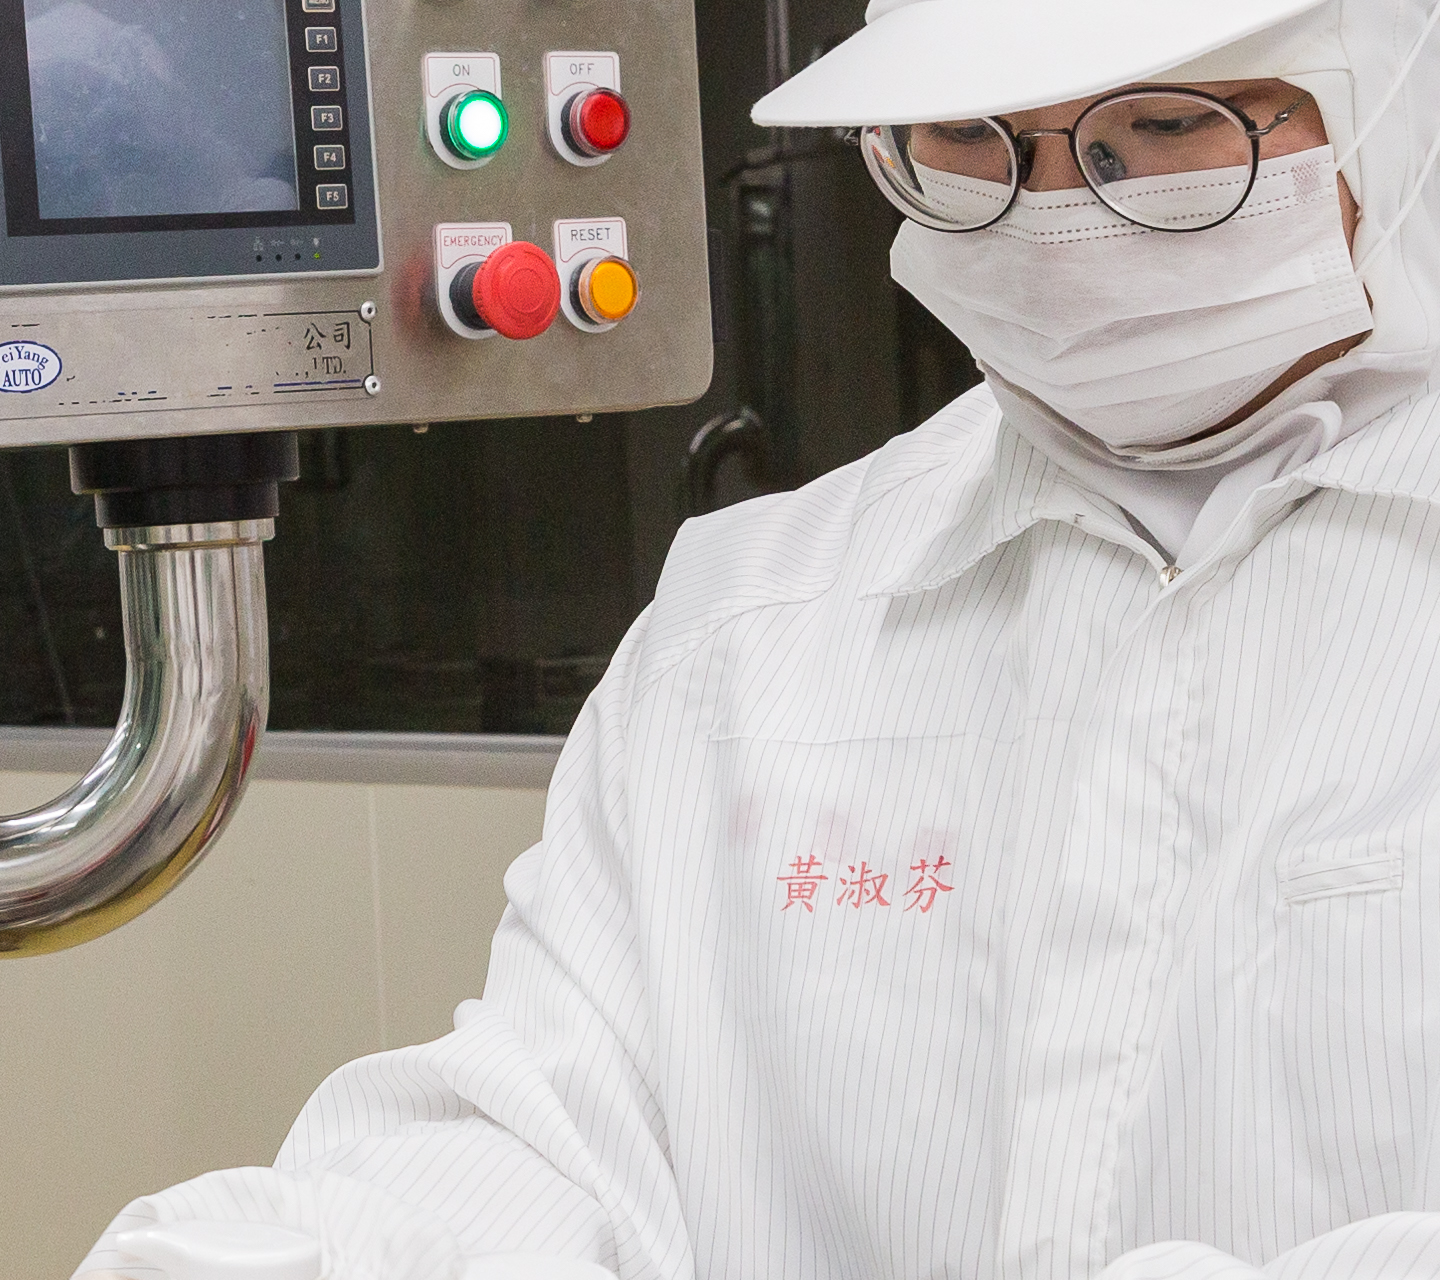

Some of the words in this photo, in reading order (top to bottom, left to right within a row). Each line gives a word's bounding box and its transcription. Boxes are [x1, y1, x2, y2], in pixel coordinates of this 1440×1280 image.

[315, 34, 328, 45] F1
[452, 64, 470, 77] ON
[570, 63, 595, 76] OFF
[318, 73, 332, 84] F2
[321, 112, 335, 123] F3
[323, 152, 337, 162] F4
[326, 191, 339, 201] F5
[443, 234, 504, 248] EMERGENCY
[570, 227, 612, 242] RESET
[303, 322, 351, 350] 公司
[2, 368, 42, 388] AUTO
[776, 854, 955, 913] 黃淑芬
